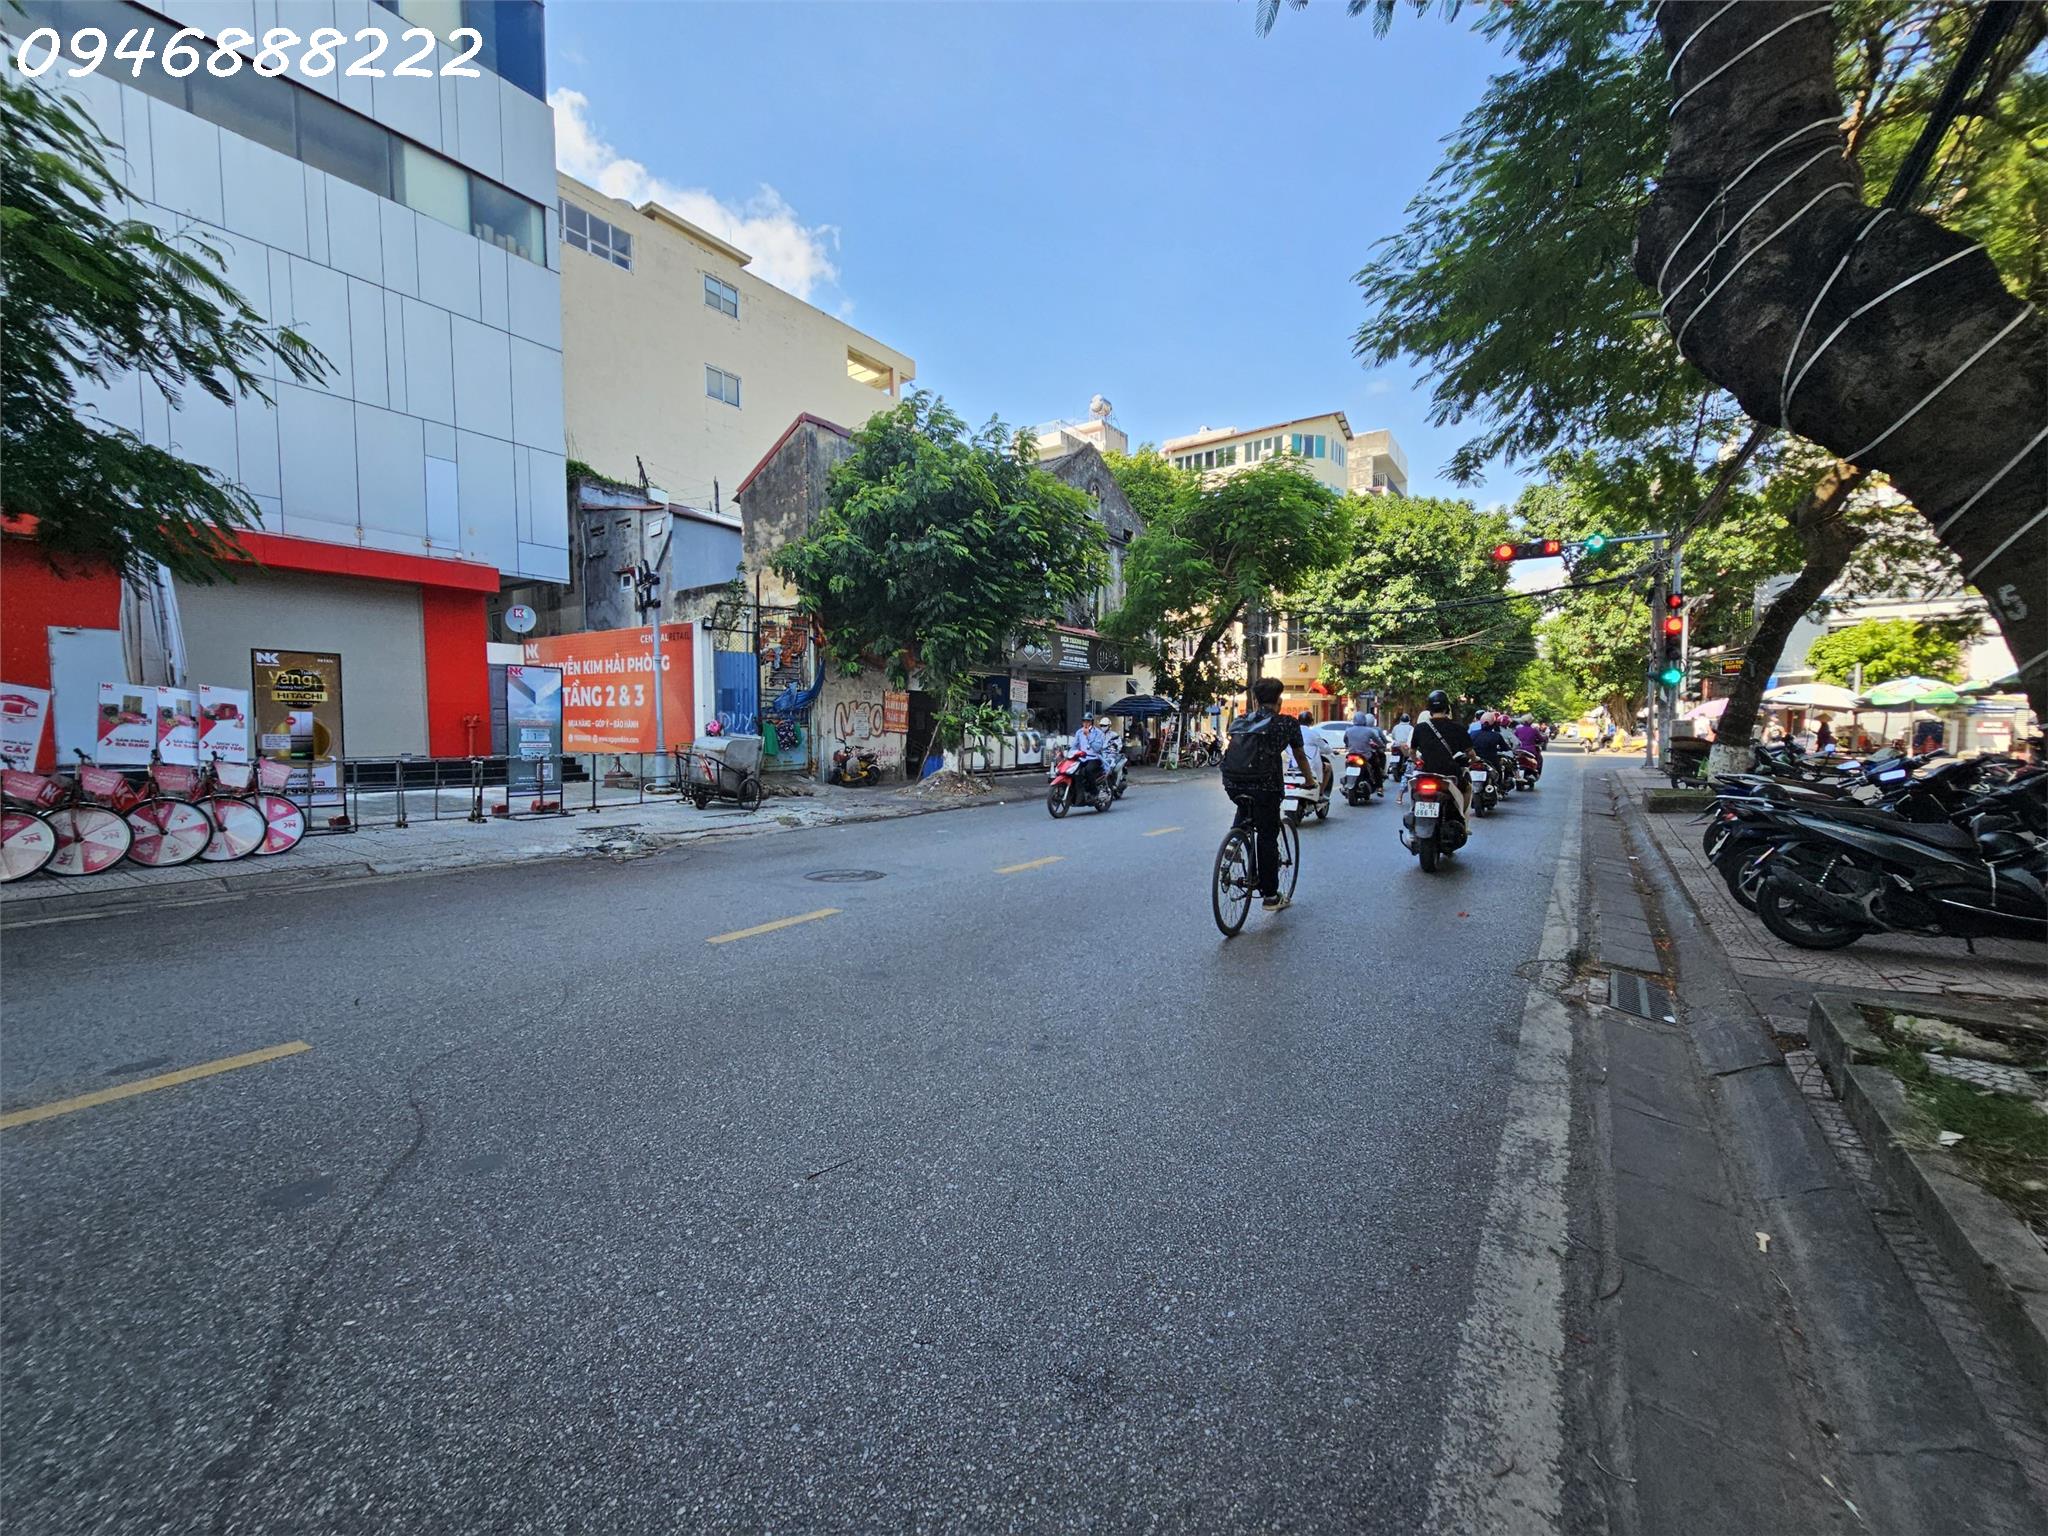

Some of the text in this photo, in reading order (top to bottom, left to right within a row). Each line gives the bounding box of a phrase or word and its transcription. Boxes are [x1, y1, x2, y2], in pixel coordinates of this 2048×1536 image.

[256, 652, 280, 664] NK
[525, 644, 539, 659] NK
[583, 660, 603, 674] KIM
[605, 653, 625, 674] HẢI
[627, 652, 671, 673] PHÒG
[509, 666, 523, 676] NK
[277, 692, 323, 700] HITACHI
[563, 679, 645, 707] TẦNG 2 & 3
